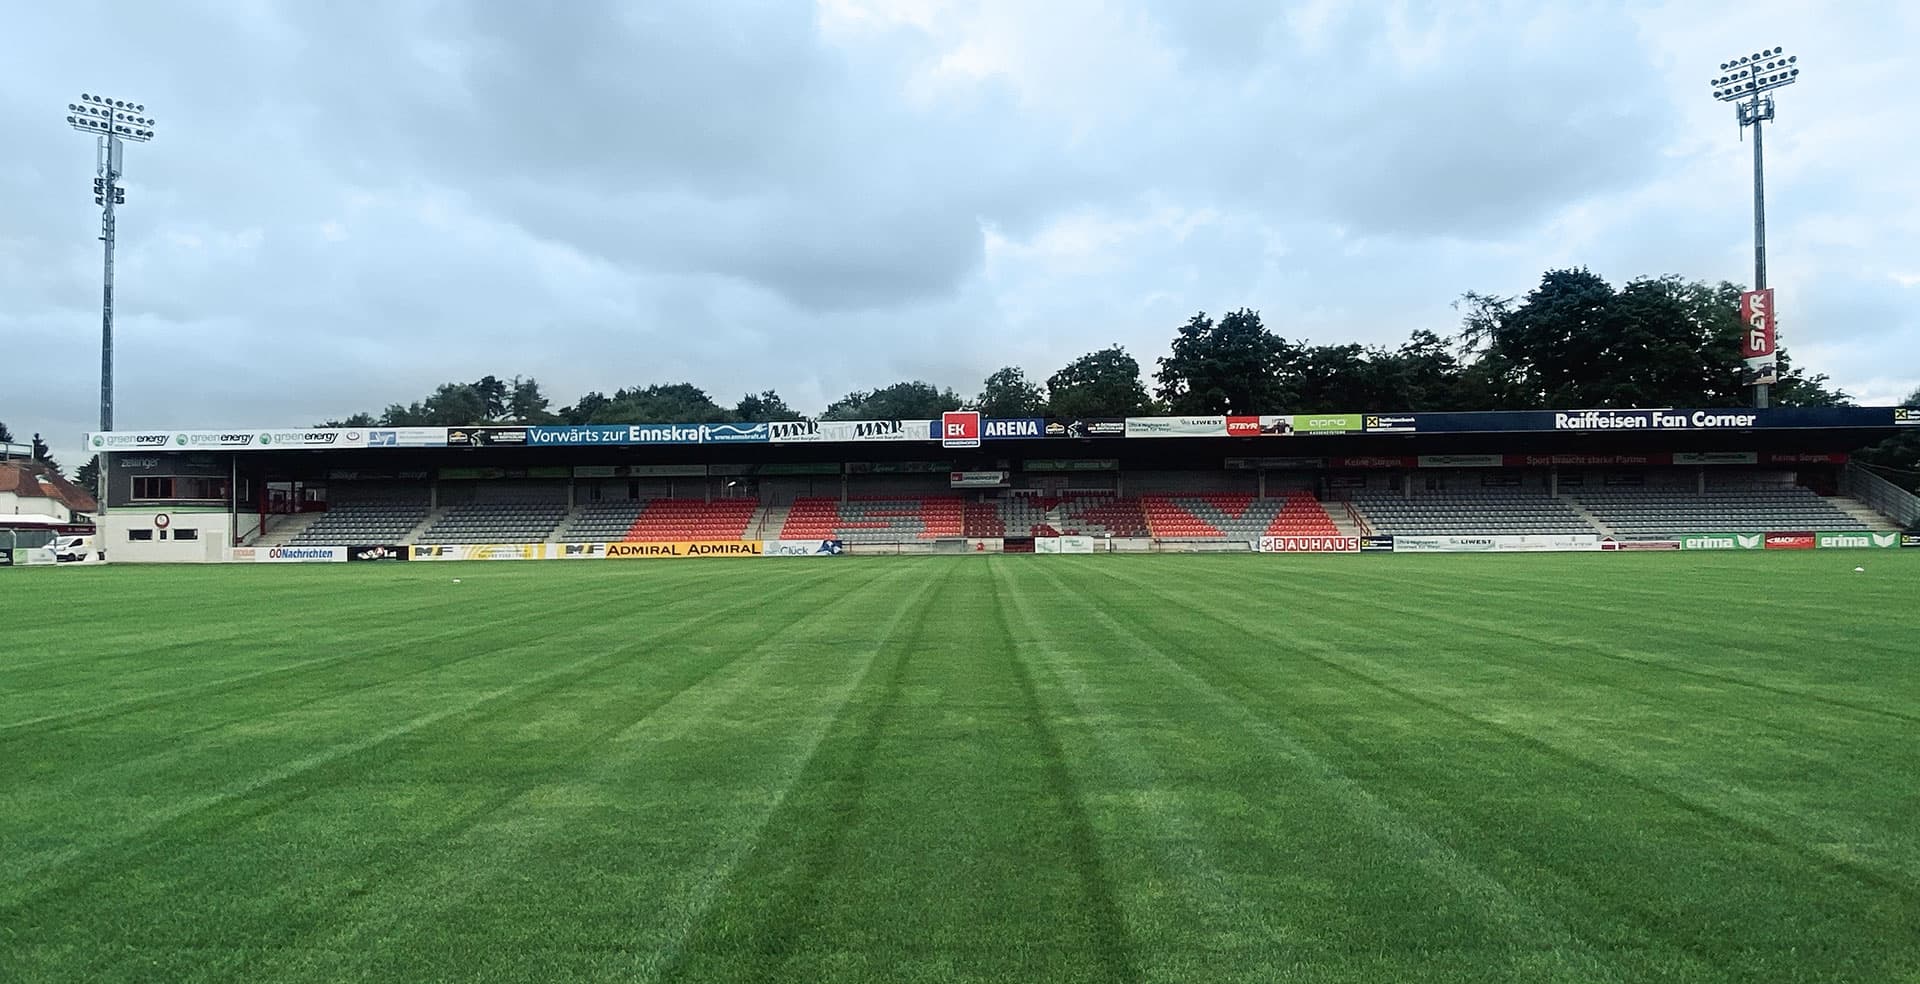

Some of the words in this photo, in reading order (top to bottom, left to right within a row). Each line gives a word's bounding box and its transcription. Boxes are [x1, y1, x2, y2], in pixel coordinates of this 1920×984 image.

[1750, 294, 1766, 352] STEYR
[769, 417, 821, 438] MAYR
[1555, 412, 1647, 429] Raiffeisen
[1652, 412, 1687, 428] Fan
[1692, 411, 1756, 427] Corner
[530, 427, 598, 442] Vorwärts
[602, 430, 625, 441] zur
[629, 425, 711, 443] Ennskraft
[852, 419, 904, 440] MAYR
[948, 424, 965, 435] EK
[985, 421, 1038, 436] ARENA
[1274, 538, 1358, 550] BAUHAUS
[1686, 536, 1734, 549] erima
[1820, 535, 1869, 548] erima
[607, 545, 681, 556] ADMIRAL
[688, 544, 761, 555] ADMIRAL
